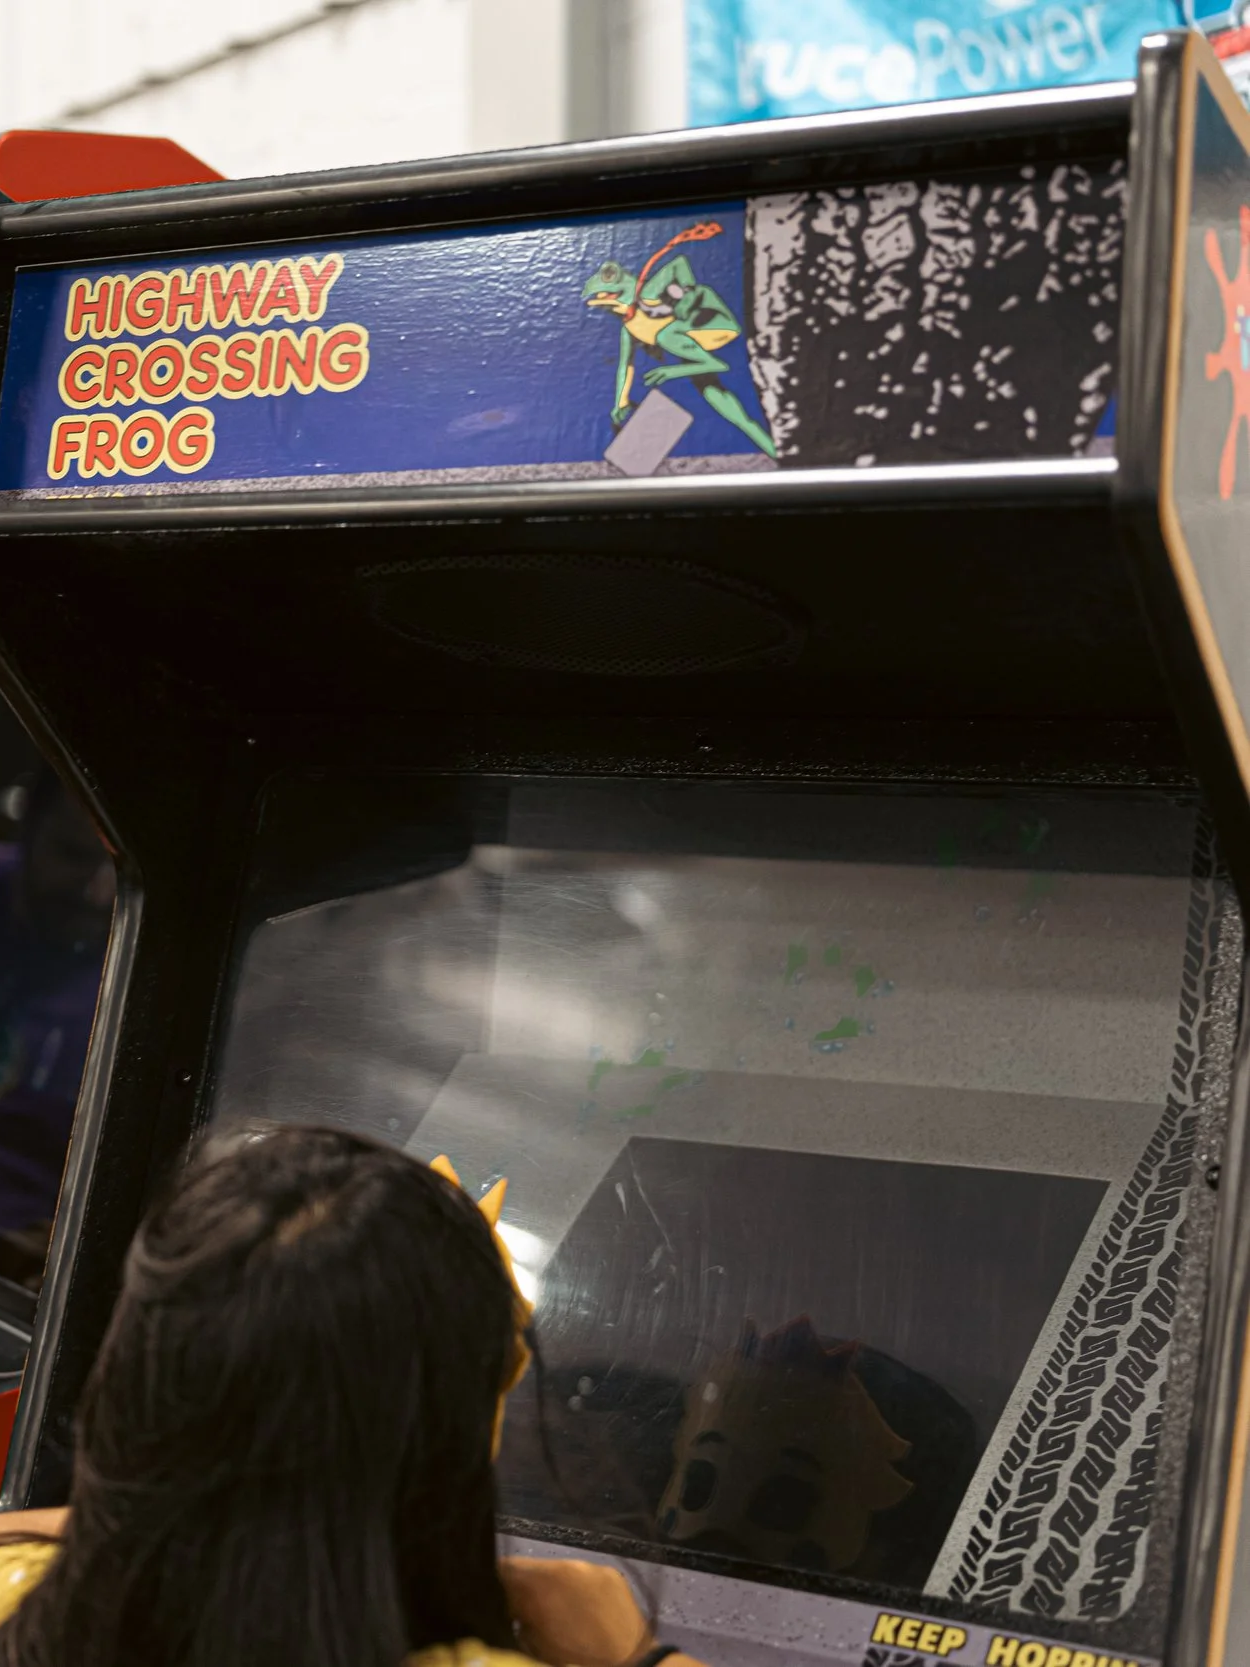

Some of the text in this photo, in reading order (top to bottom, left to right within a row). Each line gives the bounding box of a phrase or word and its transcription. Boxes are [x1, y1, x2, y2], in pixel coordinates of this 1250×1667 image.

[65, 253, 345, 342] HIGHWAY
[58, 322, 369, 410] CROSSING
[47, 406, 215, 480] FROG
[870, 1613, 1139, 1667] KEEP HOPP
